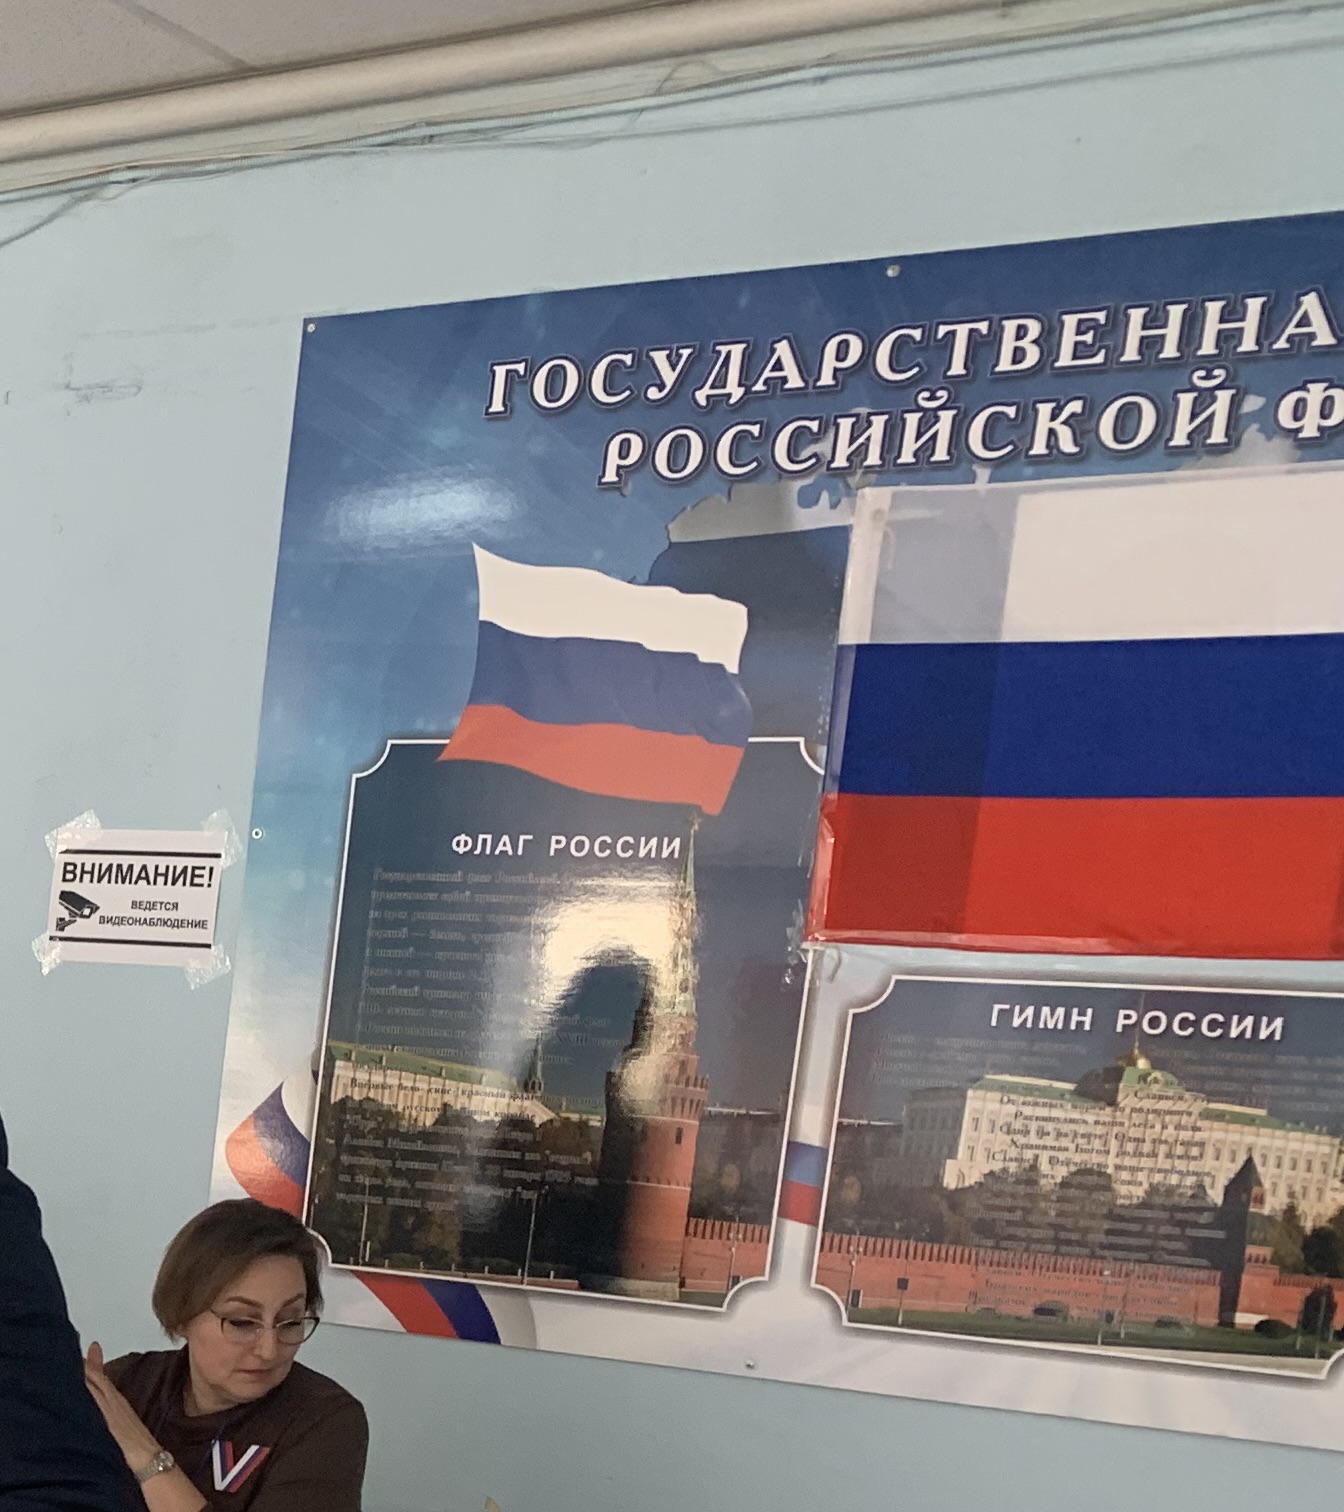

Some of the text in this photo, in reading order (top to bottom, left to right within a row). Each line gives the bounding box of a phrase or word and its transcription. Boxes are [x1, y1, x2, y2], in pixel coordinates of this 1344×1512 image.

[485, 290, 1339, 415] ГОСУДАРСТВЕННА
[598, 367, 1237, 484] РОССИЙСКОЙ
[451, 833, 683, 860] ФЛАГ РОССИИ
[61, 861, 215, 888] ВНИМАНИЕ!
[130, 899, 180, 912] ВЕДЕТСЯ
[98, 915, 209, 930] ВИДЕОНАБЛЮДЕНИЕ
[989, 1003, 1286, 1041] ГИМН РОССИИ
